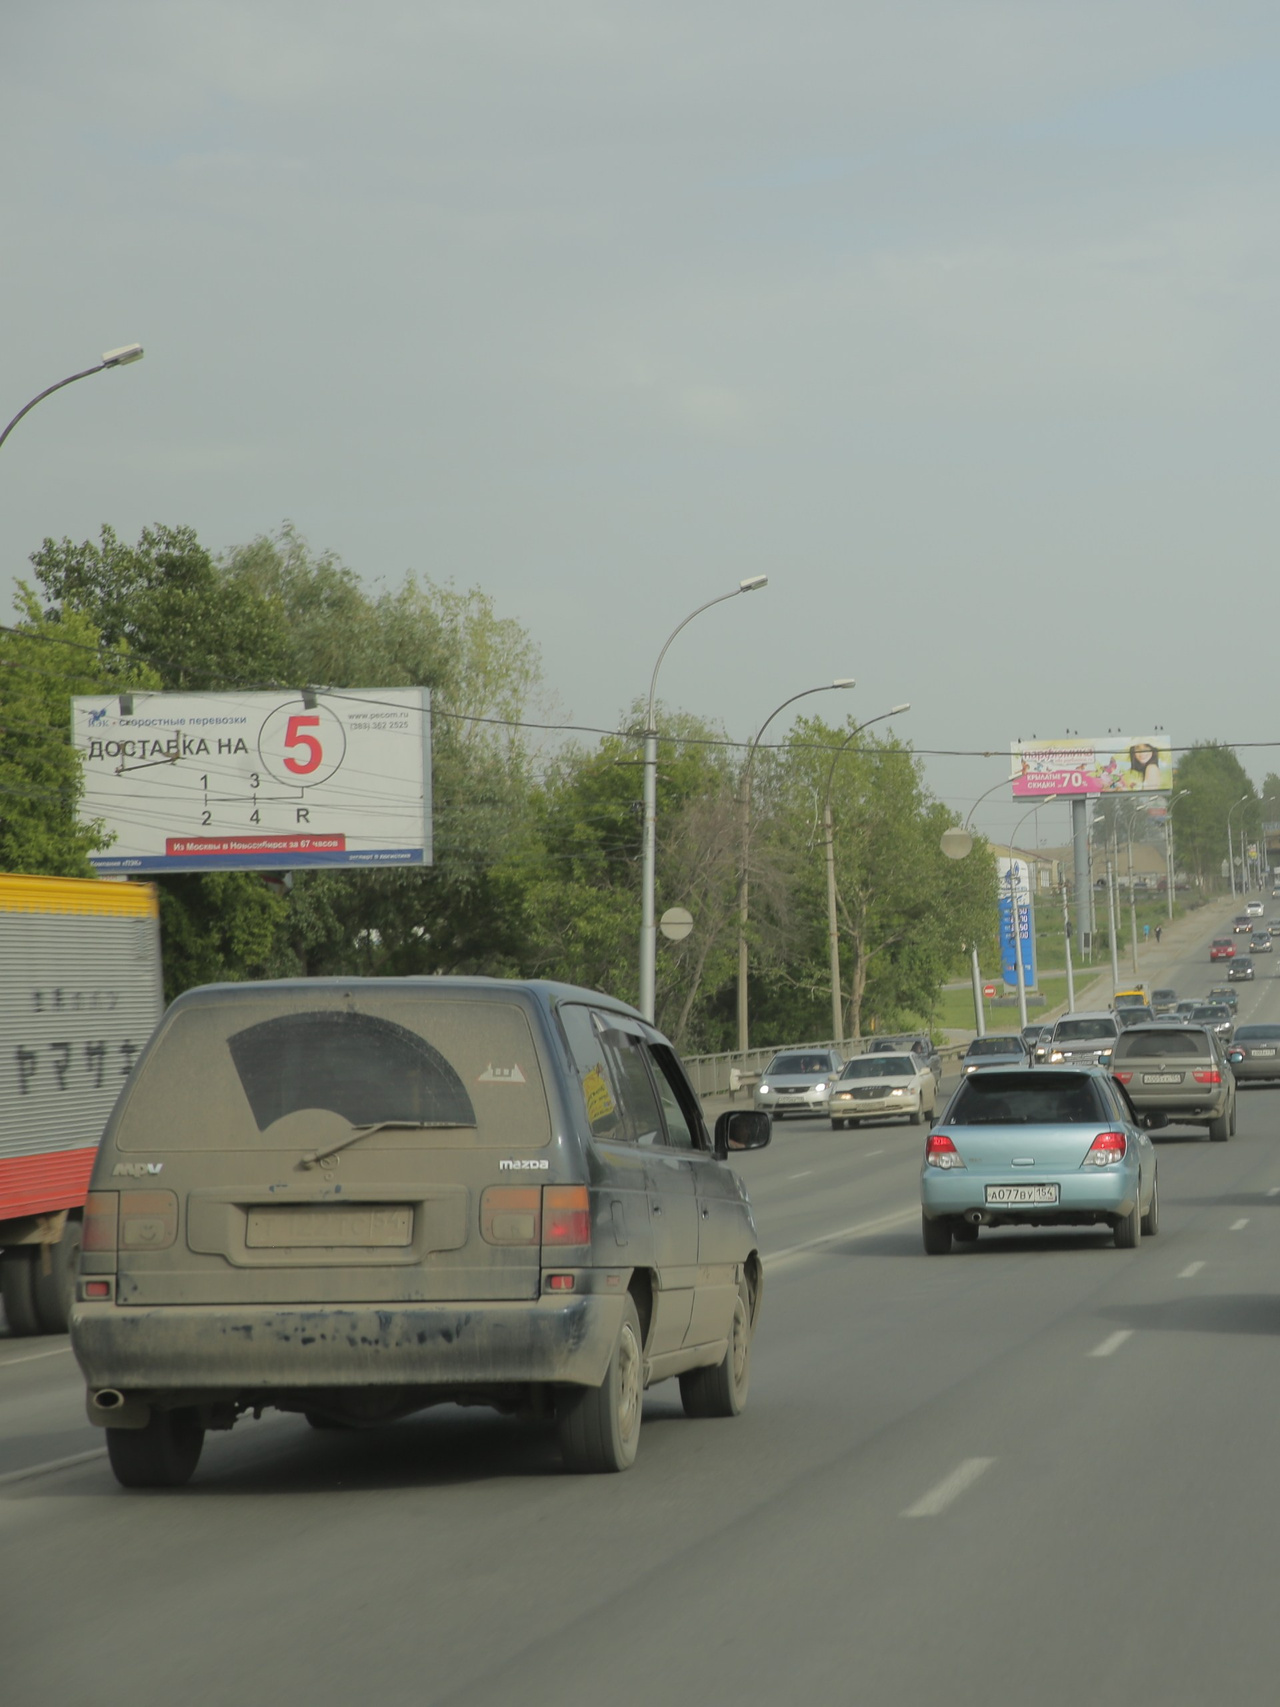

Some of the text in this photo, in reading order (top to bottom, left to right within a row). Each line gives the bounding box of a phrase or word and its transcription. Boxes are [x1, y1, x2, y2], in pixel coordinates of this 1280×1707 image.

[119, 718, 186, 728] скоростные
[189, 717, 247, 726] перевозки
[89, 738, 248, 760] ДОСТАВКА НА
[283, 715, 322, 775] 5
[250, 773, 260, 788] 3
[201, 808, 310, 826] 2 4 R
[174, 843, 184, 851] Из
[187, 842, 220, 850] Москвы
[230, 840, 287, 849] Новосибирск
[300, 840, 310, 848] 67
[313, 840, 338, 848] часов
[991, 1187, 1053, 1201] А077ВУ 154
